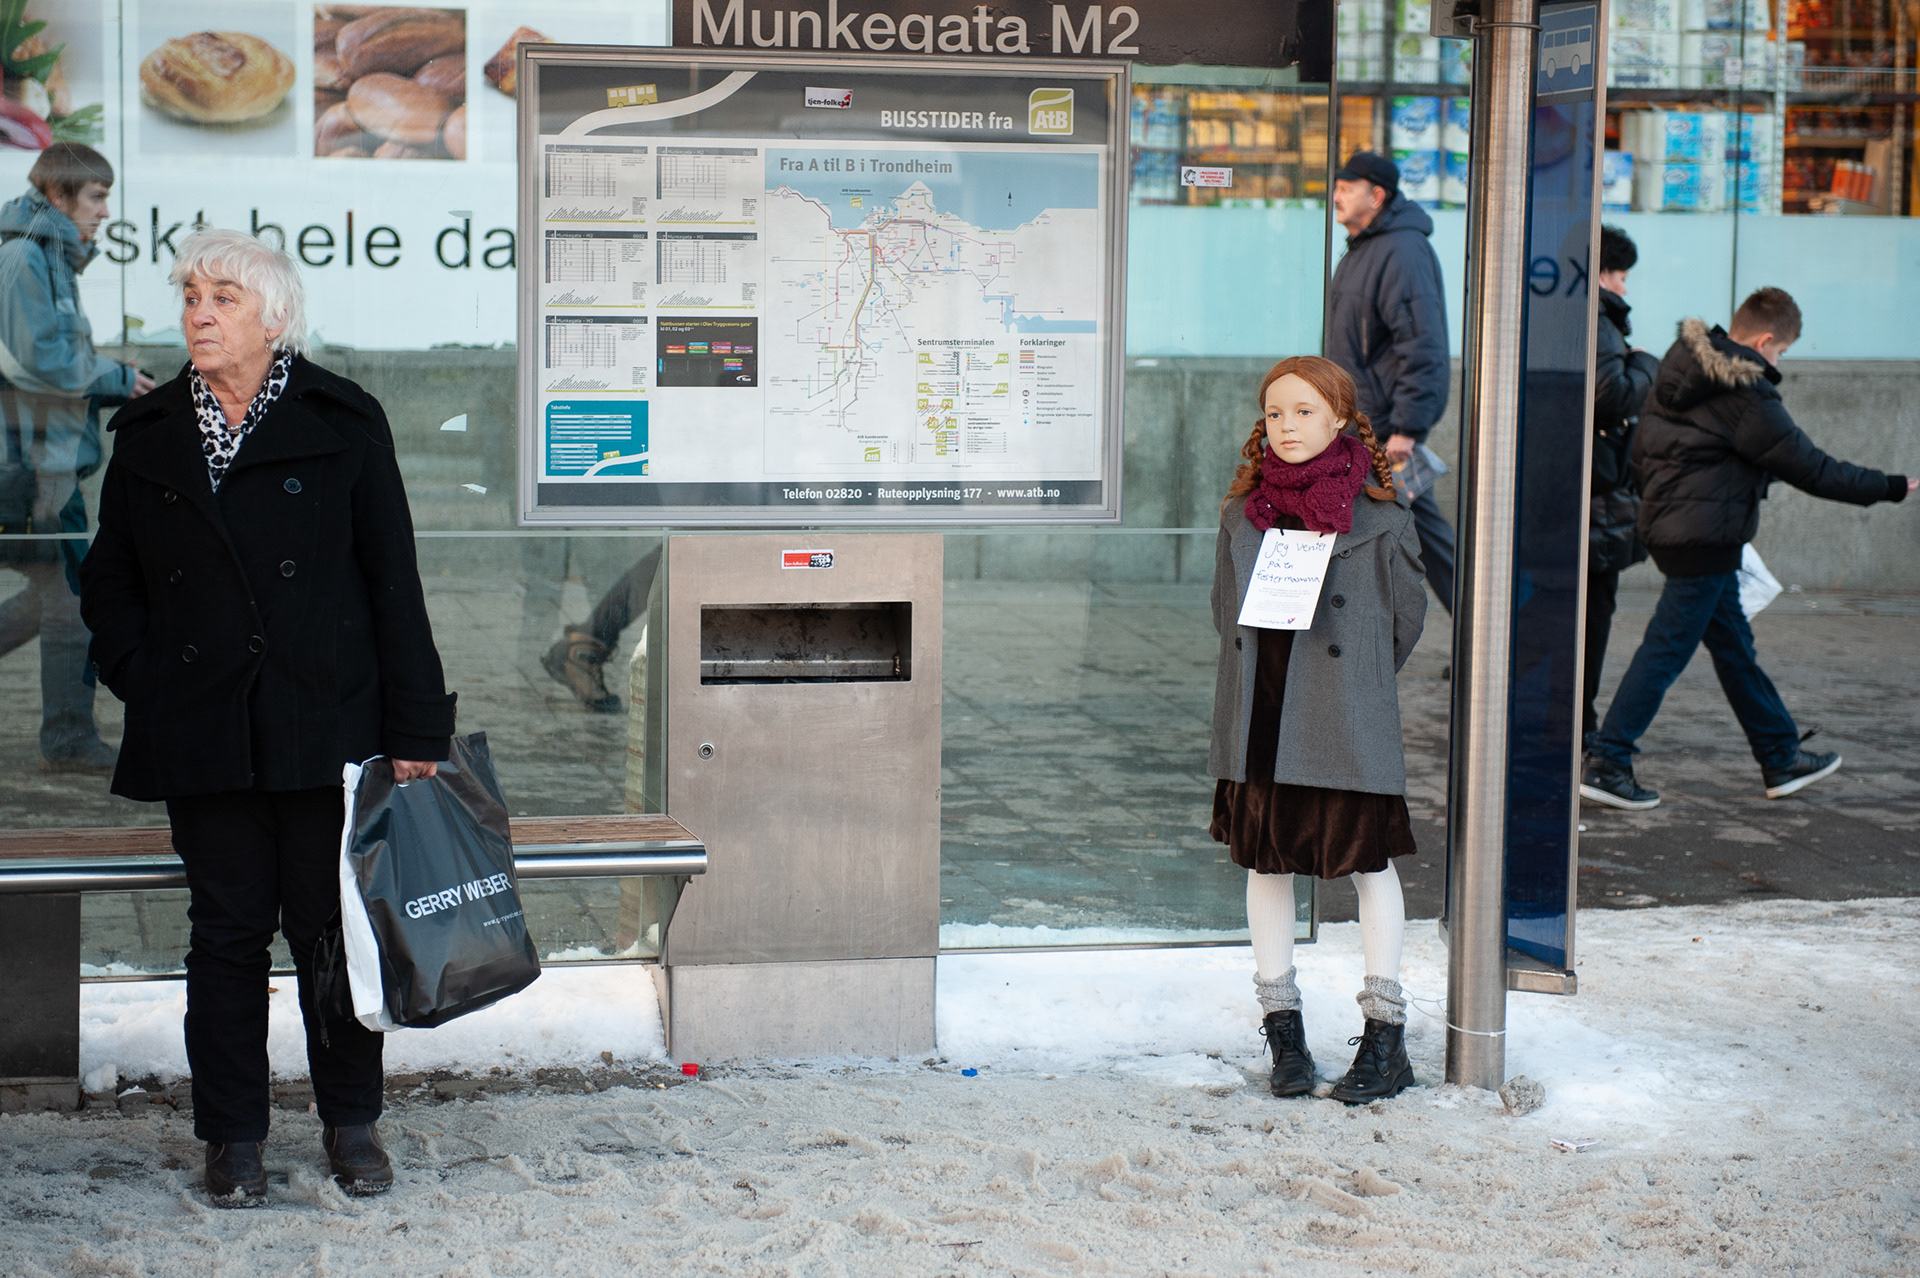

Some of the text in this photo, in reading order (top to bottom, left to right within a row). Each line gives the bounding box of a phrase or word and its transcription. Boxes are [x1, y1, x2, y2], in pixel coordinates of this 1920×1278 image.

[691, 0, 1140, 54] Munkegata M2
[880, 110, 1013, 130] BUSSTIDER fra
[1034, 110, 1068, 129] AtB
[780, 158, 953, 174] Fra A til B i Trondheim
[917, 338, 995, 346] Sentrumsterminalen
[1019, 338, 1066, 348] Forklaringer
[783, 488, 822, 499] Telefon
[825, 488, 862, 499] 02820
[877, 488, 961, 501] Ruteopplysning
[963, 488, 983, 499] 177
[997, 487, 1060, 499] www.atb.no
[405, 872, 512, 920] GERRY WEBER
